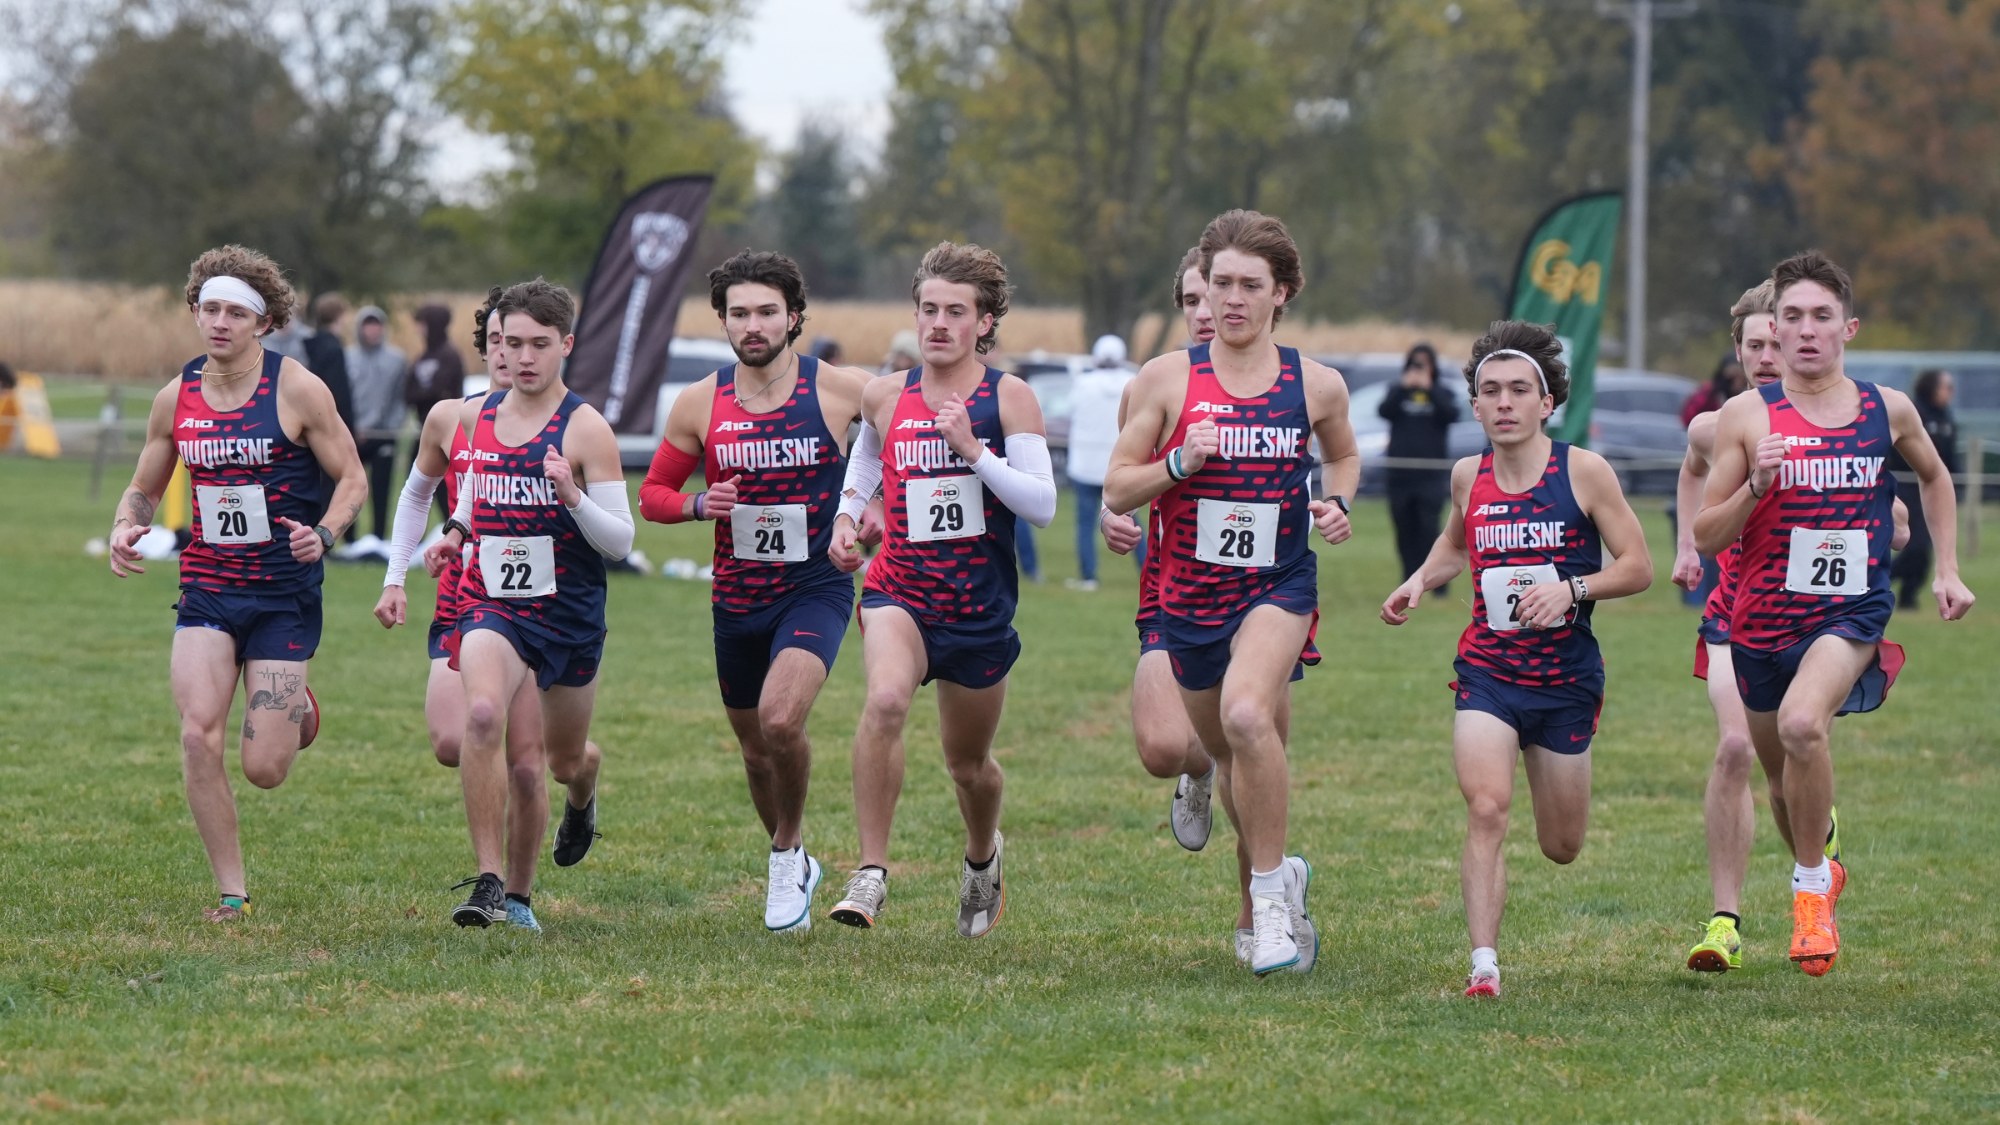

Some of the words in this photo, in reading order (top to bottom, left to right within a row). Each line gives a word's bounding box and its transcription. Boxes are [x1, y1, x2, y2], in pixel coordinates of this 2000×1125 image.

[1190, 401, 1233, 413] A10
[178, 418, 214, 428] A10
[715, 421, 753, 432] A10
[895, 419, 932, 429] A10
[178, 438, 274, 469] DUQUESNE
[472, 449, 499, 461] A10
[714, 437, 820, 472] DUQUESNE
[930, 489, 957, 497] A10
[1472, 504, 1509, 516] A10
[929, 503, 964, 532] 29
[1223, 514, 1252, 523] A10
[217, 511, 248, 537] 20
[755, 529, 786, 554] 24
[1475, 521, 1565, 552] DUQUESNE
[1219, 529, 1255, 559] 28
[1816, 542, 1844, 550] A10
[501, 563, 532, 590] 22
[1810, 557, 1847, 586] 26
[1507, 578, 1533, 586] A10
